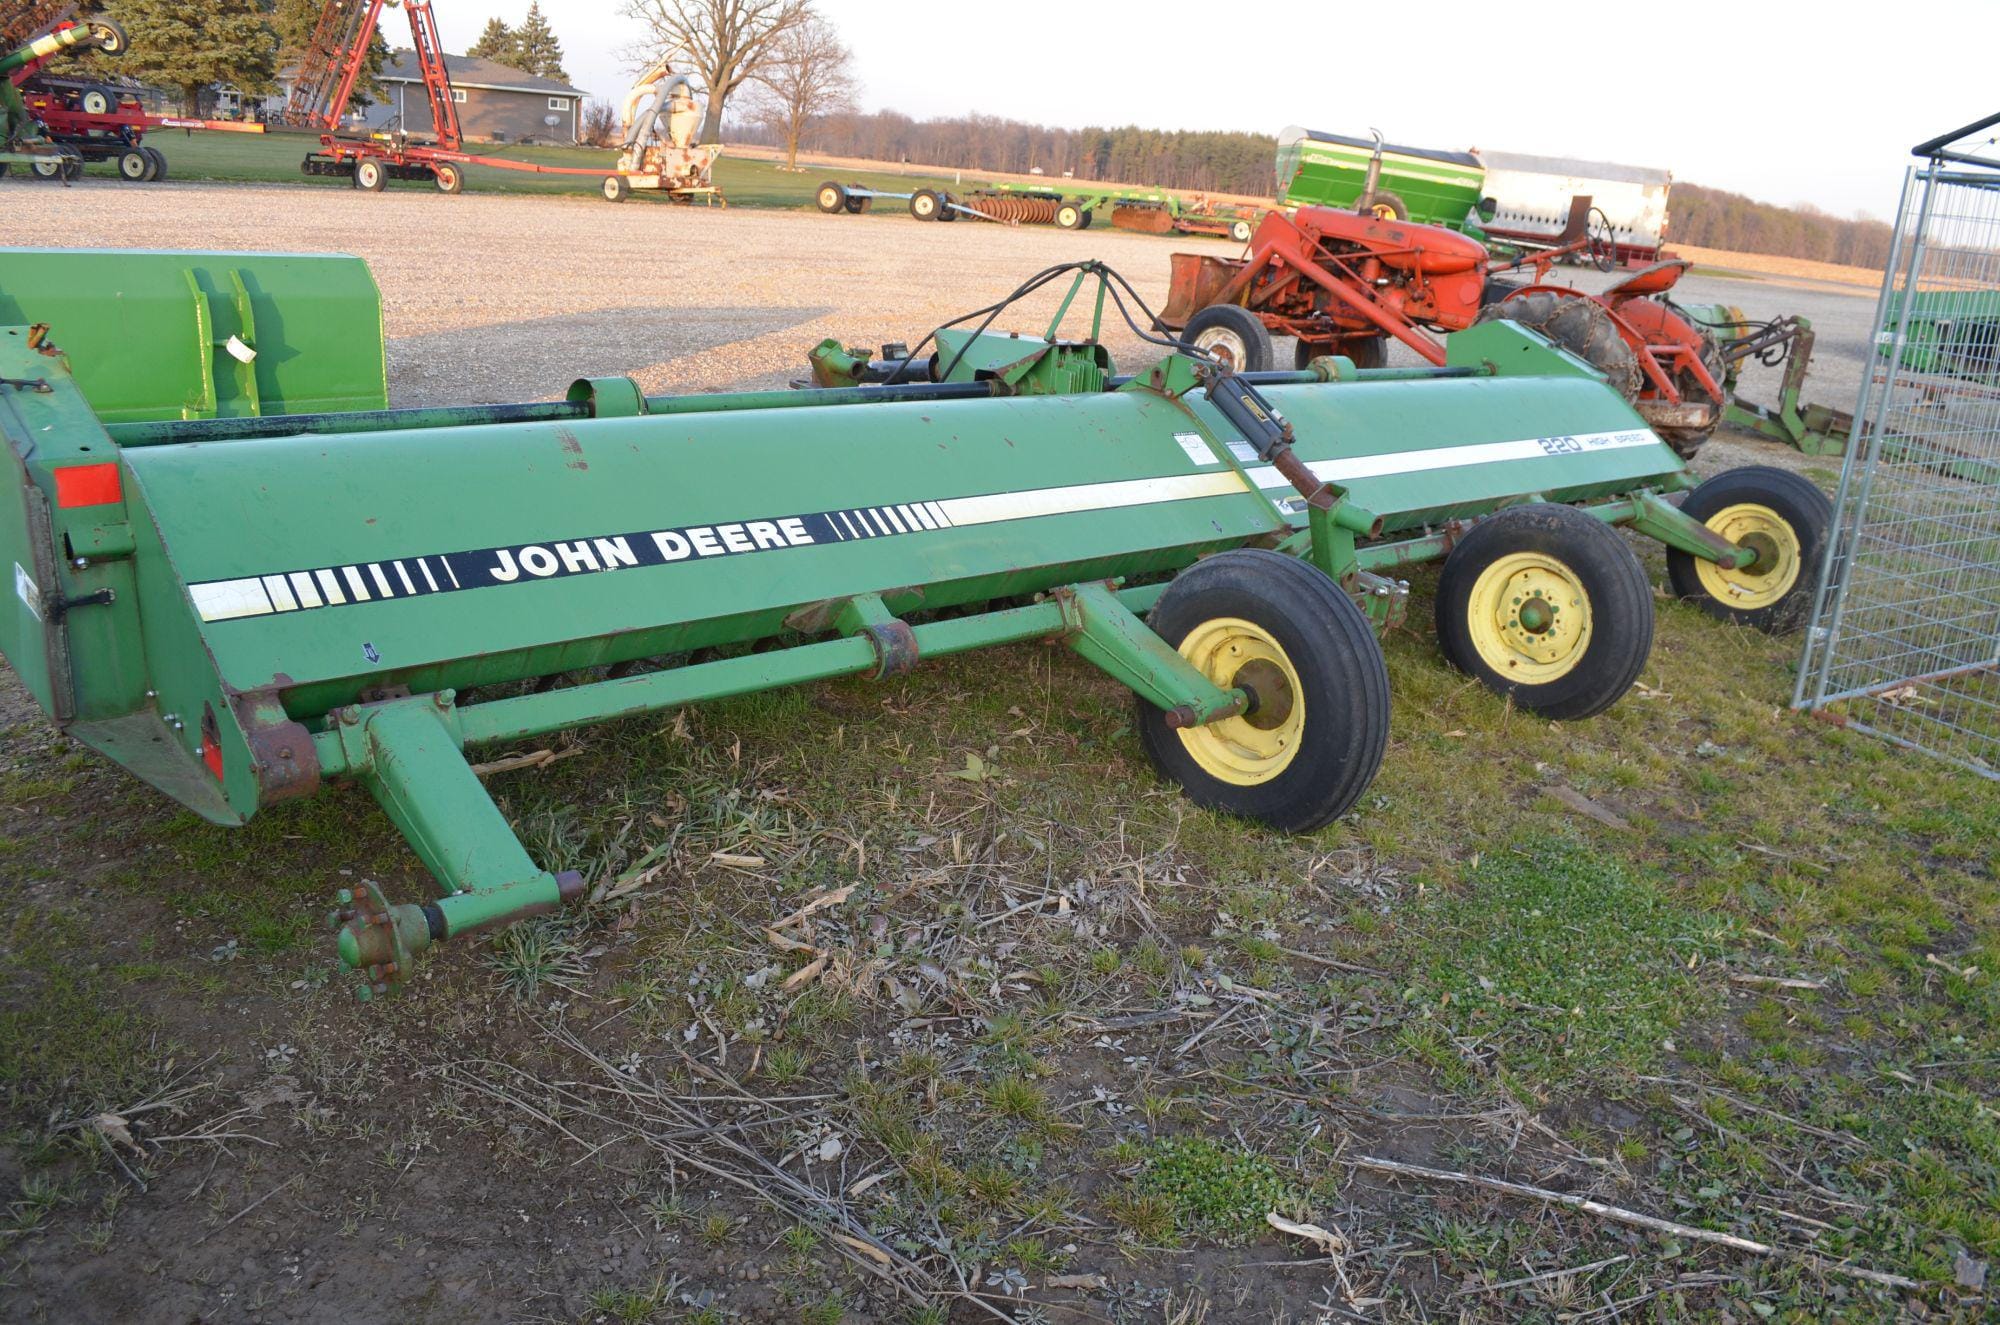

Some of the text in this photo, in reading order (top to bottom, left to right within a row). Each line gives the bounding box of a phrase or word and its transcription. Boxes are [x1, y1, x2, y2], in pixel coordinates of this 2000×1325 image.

[1537, 436, 1583, 455] 220
[489, 517, 815, 582] JOHN DEERE
